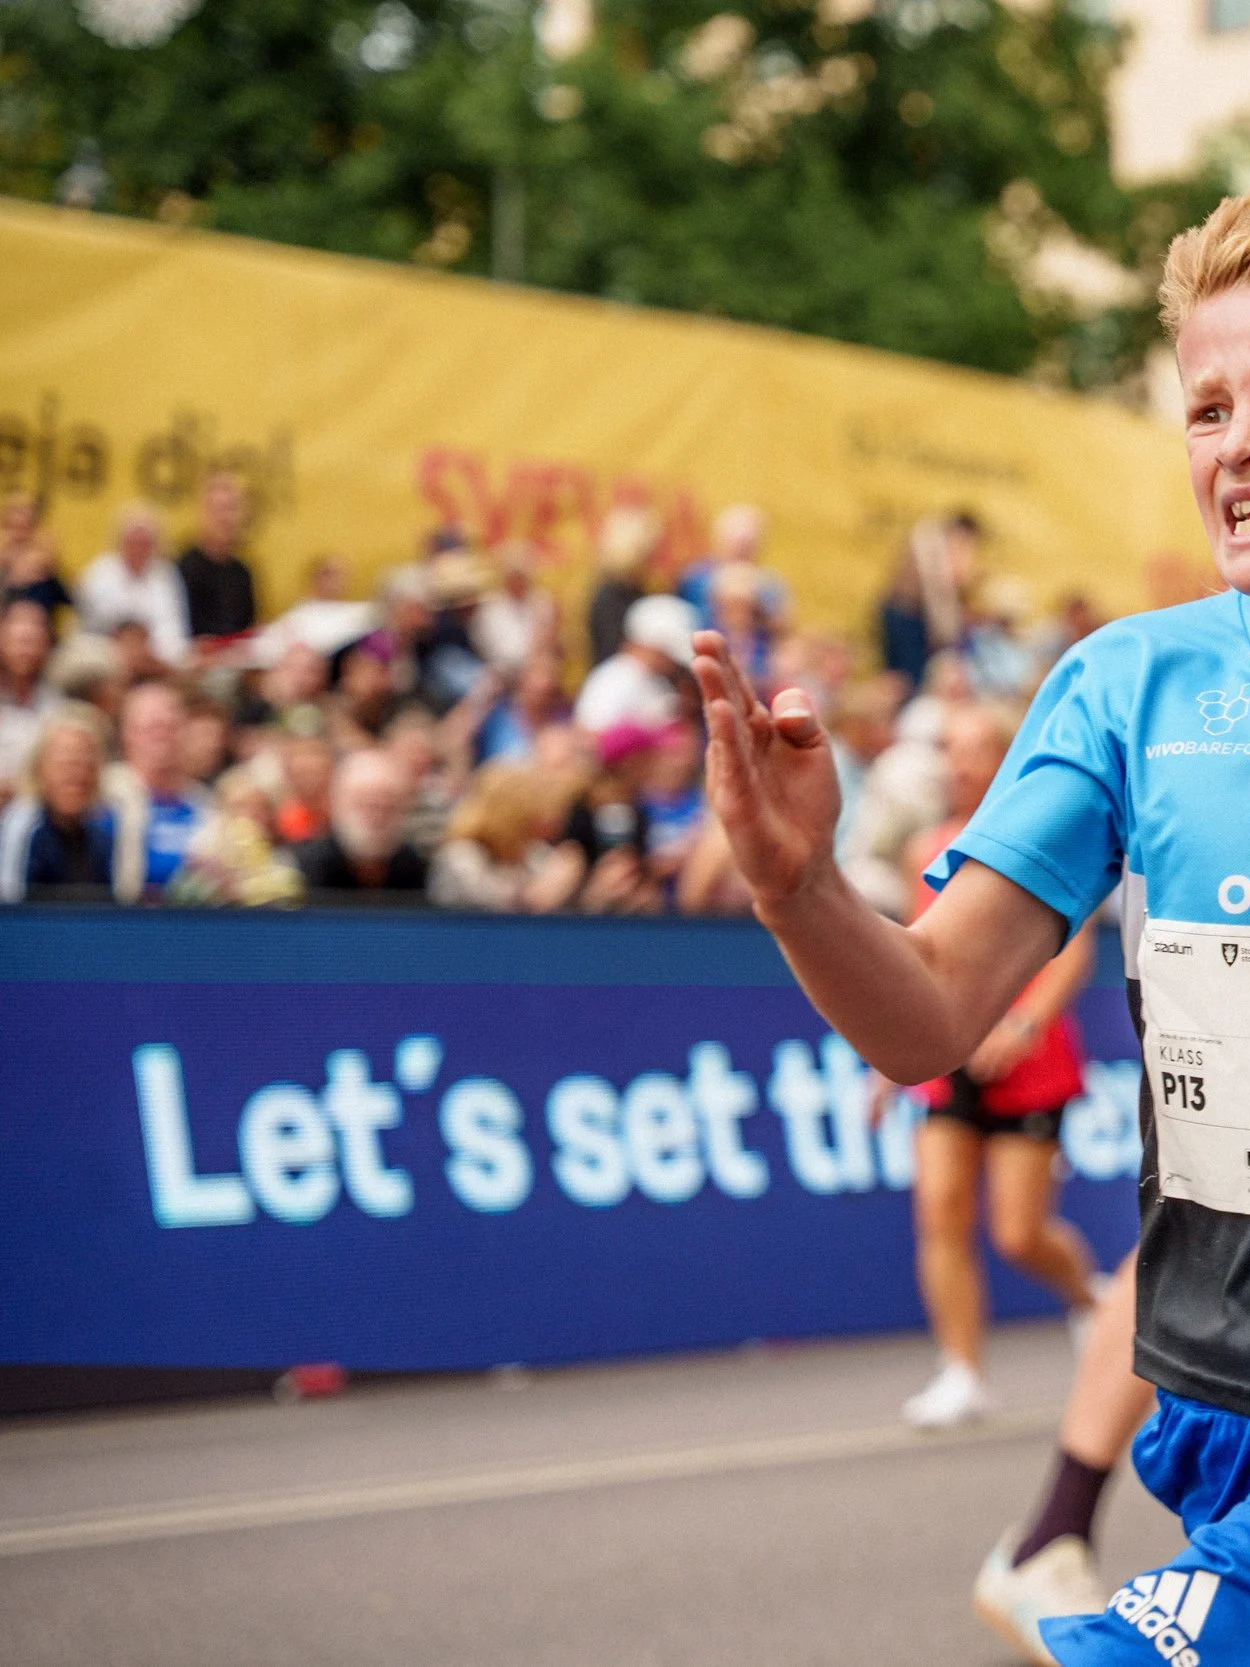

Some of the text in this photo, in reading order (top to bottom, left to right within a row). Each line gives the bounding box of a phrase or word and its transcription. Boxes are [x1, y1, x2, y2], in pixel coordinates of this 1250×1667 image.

[1154, 942, 1193, 955] stadium
[1159, 1046, 1204, 1067] KLASS
[1161, 1072, 1206, 1111] P13
[132, 1033, 532, 1229] Let's
[545, 1038, 771, 1208] set
